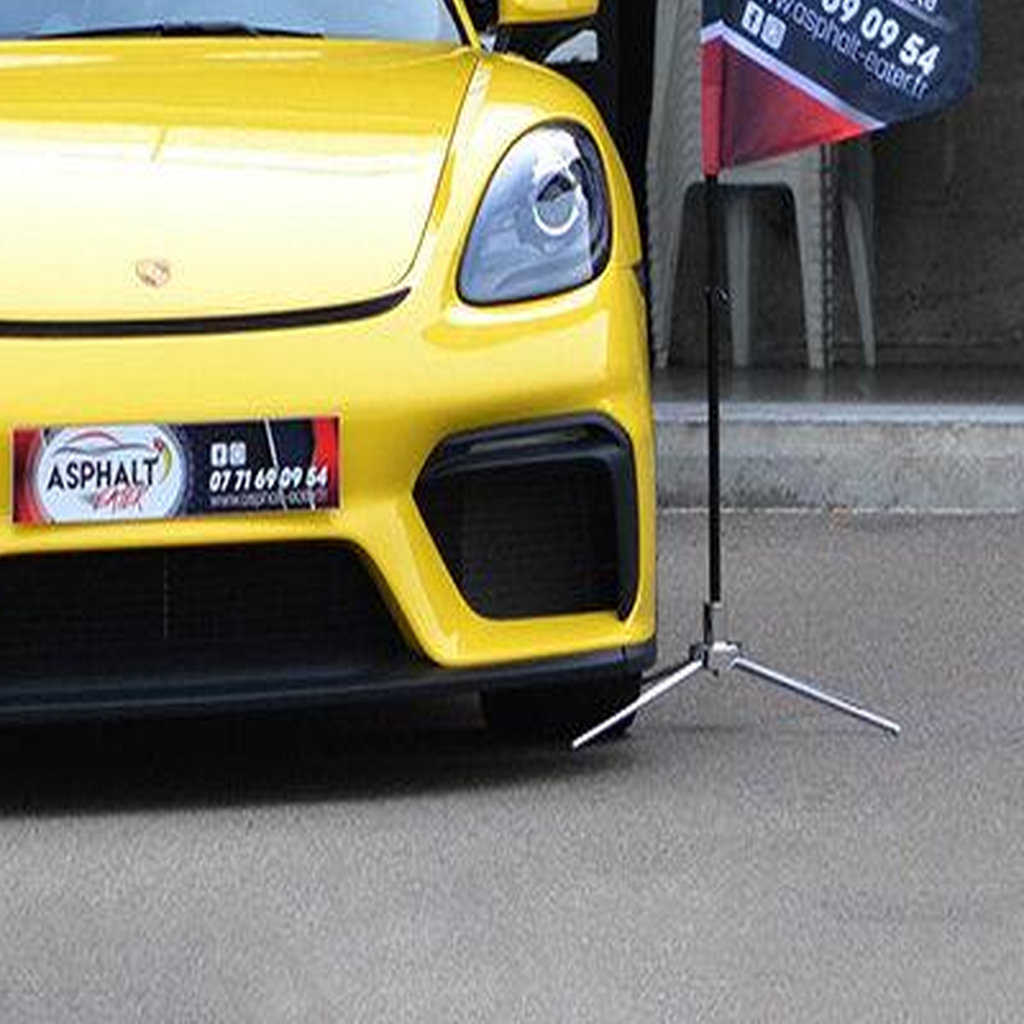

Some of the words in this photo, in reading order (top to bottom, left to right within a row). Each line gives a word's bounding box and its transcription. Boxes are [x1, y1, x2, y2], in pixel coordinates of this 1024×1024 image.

[861, 7, 900, 49] 09
[898, 33, 941, 75] 54
[47, 457, 160, 491] ASPHALT
[209, 469, 232, 492] 07
[234, 469, 252, 491] 71
[254, 467, 277, 490] 69
[278, 466, 303, 488] 09
